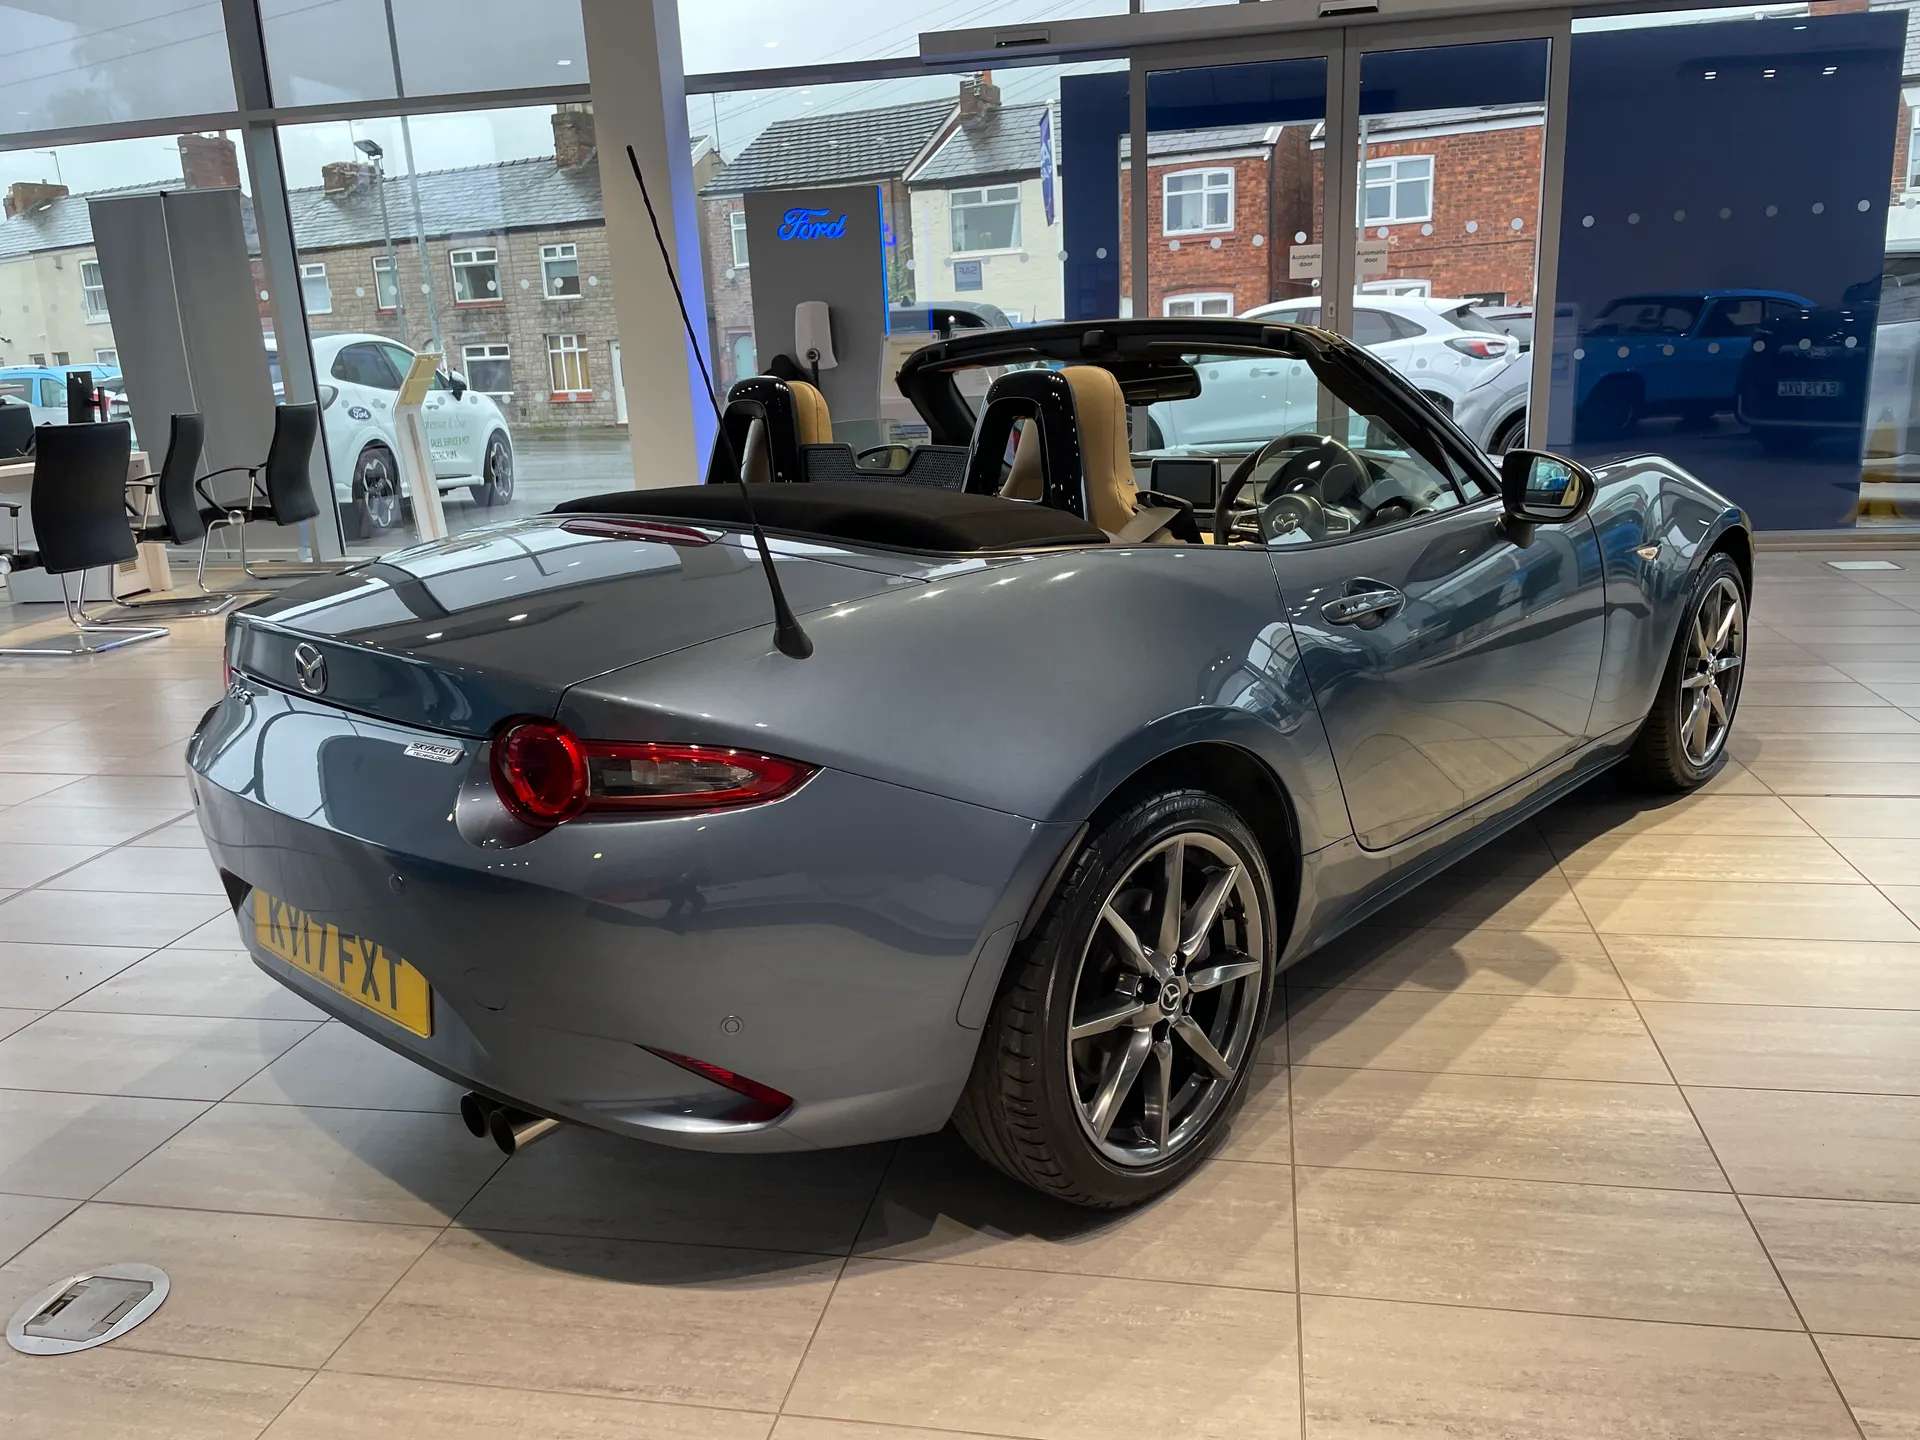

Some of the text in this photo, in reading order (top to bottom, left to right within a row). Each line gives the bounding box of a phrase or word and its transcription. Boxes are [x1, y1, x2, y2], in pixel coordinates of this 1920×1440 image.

[777, 208, 848, 240] Ford
[353, 408, 369, 418] Ford
[411, 743, 455, 755] SKYACTIV
